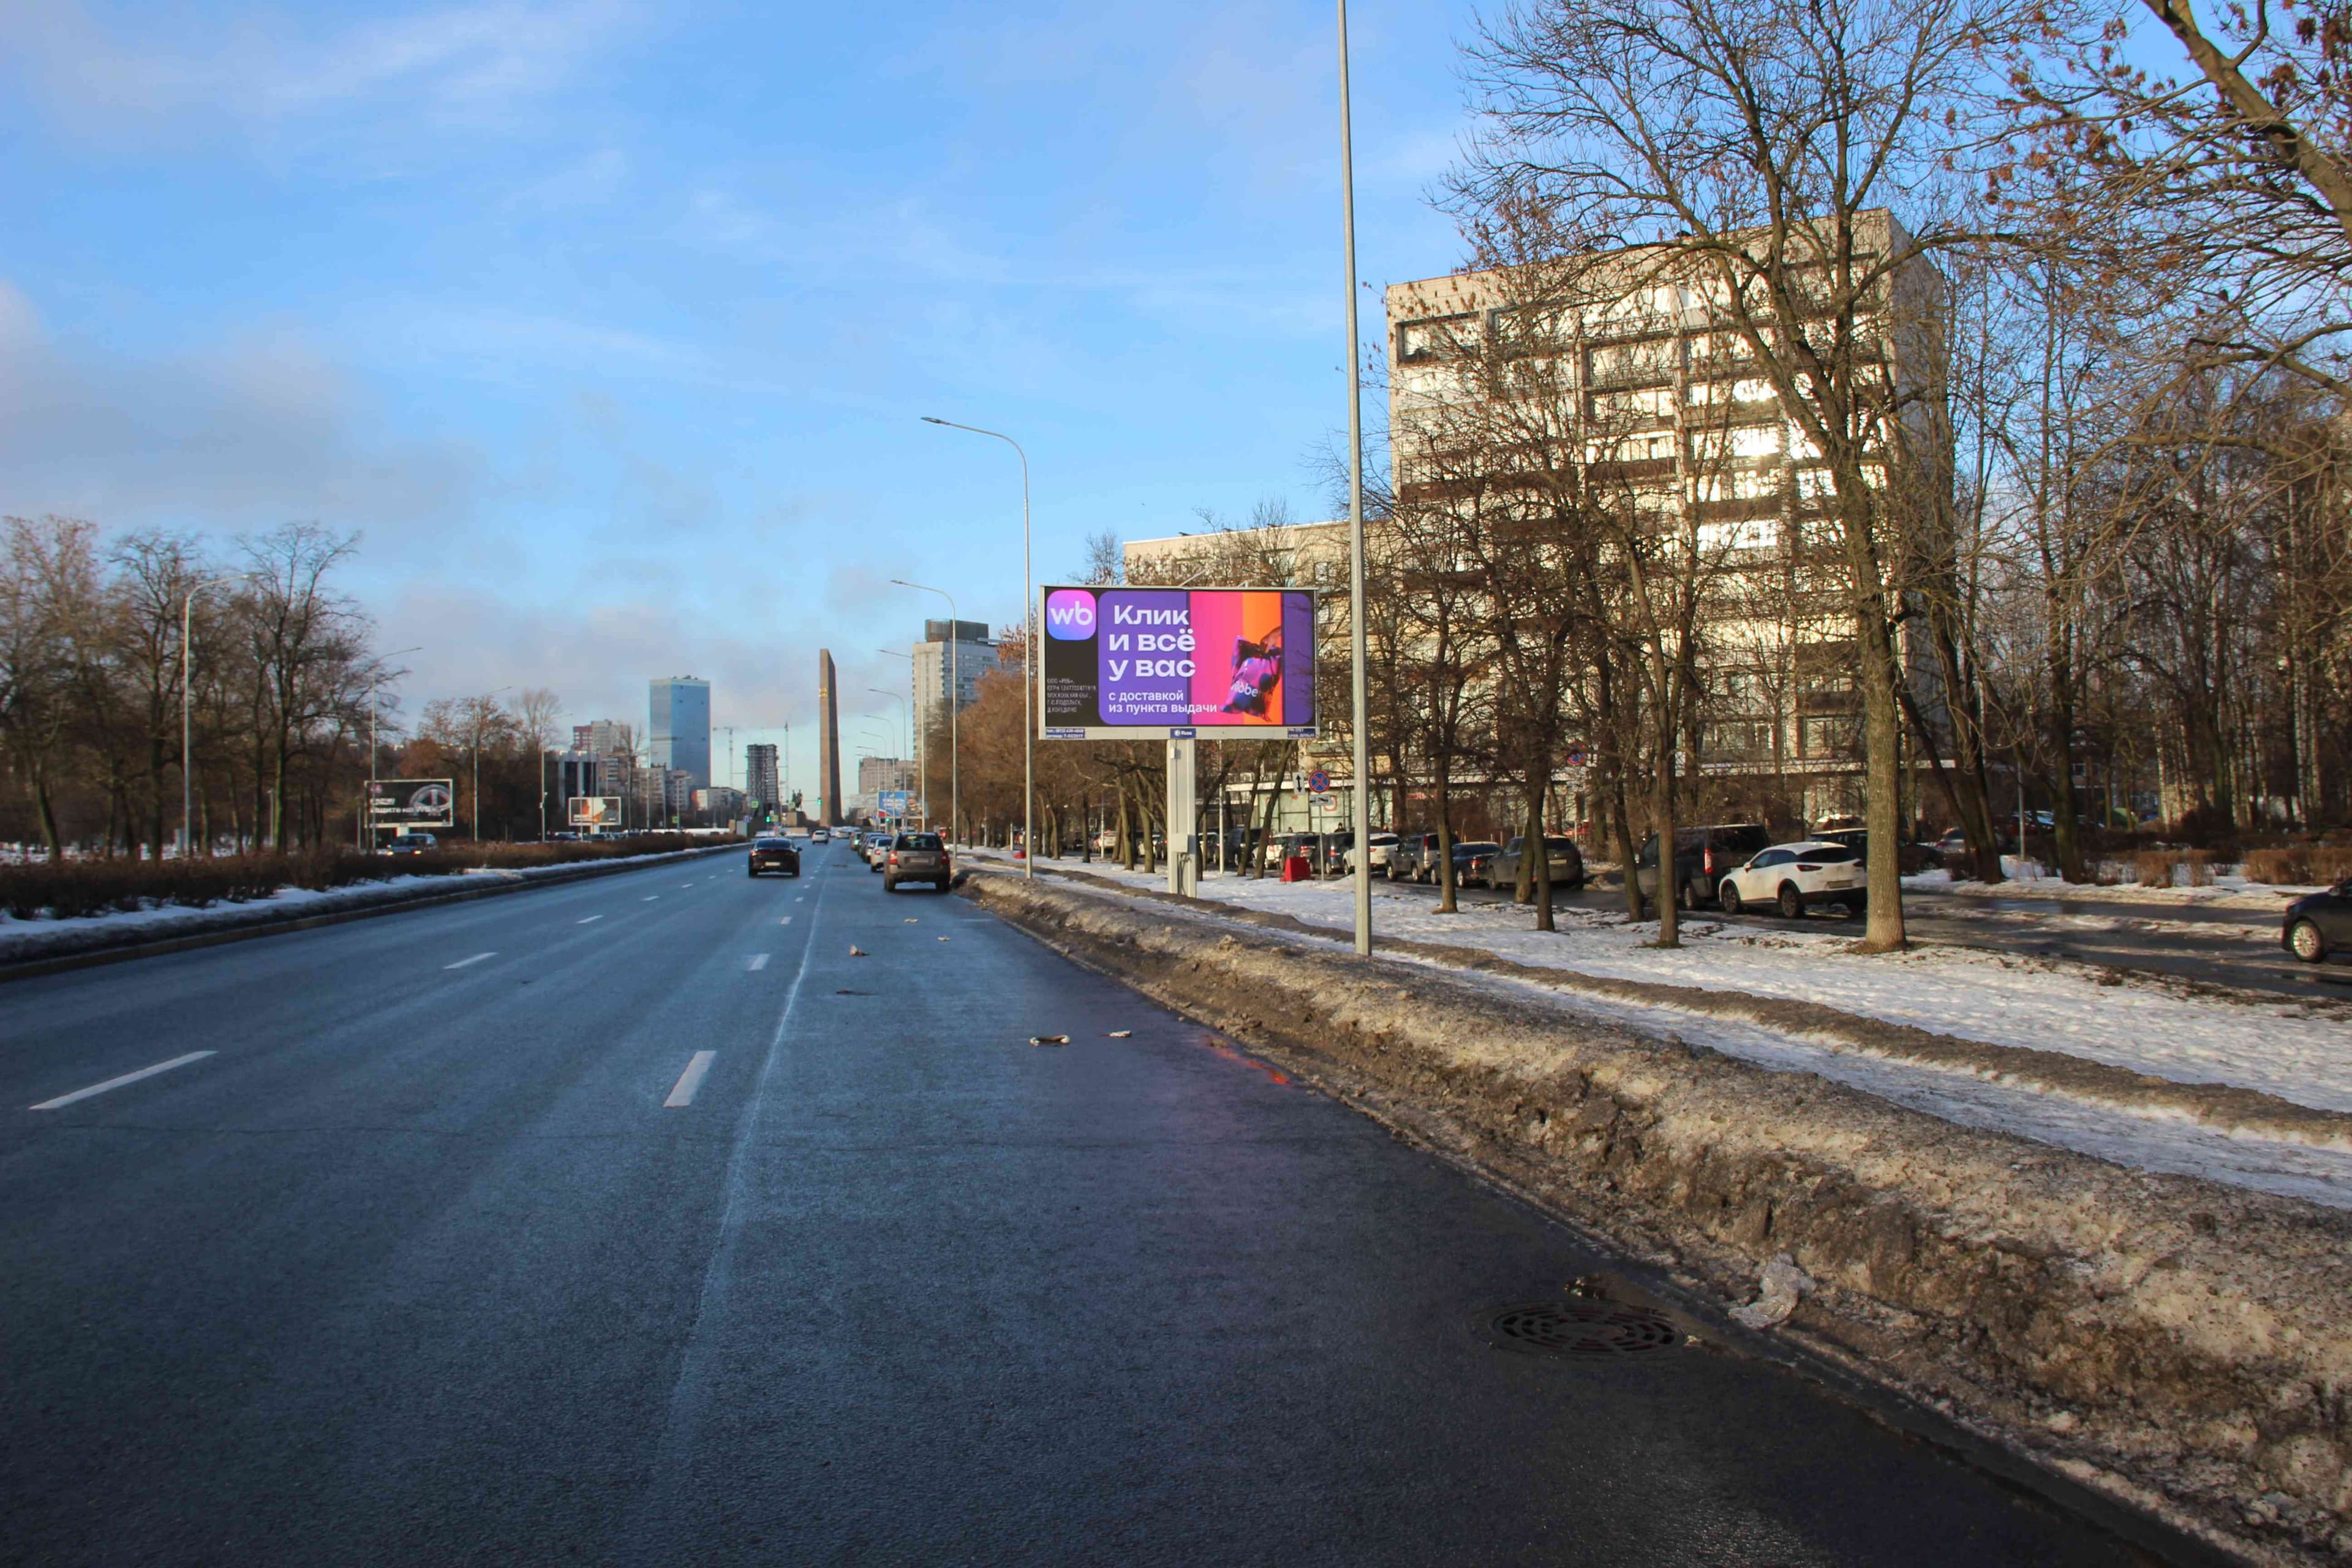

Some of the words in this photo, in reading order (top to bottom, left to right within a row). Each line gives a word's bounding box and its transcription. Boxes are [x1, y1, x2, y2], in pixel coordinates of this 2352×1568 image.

[1050, 601, 1093, 625] wb
[1114, 605, 1189, 625] Клик
[1109, 634, 1129, 651] и
[1137, 628, 1196, 652] всё
[1108, 660, 1129, 682] у
[1136, 660, 1196, 677] вас
[1109, 692, 1116, 701] с
[1119, 690, 1183, 703] доставкой
[1109, 704, 1123, 713] из
[1126, 704, 1167, 715] пункта
[1171, 704, 1217, 715] выдачи
